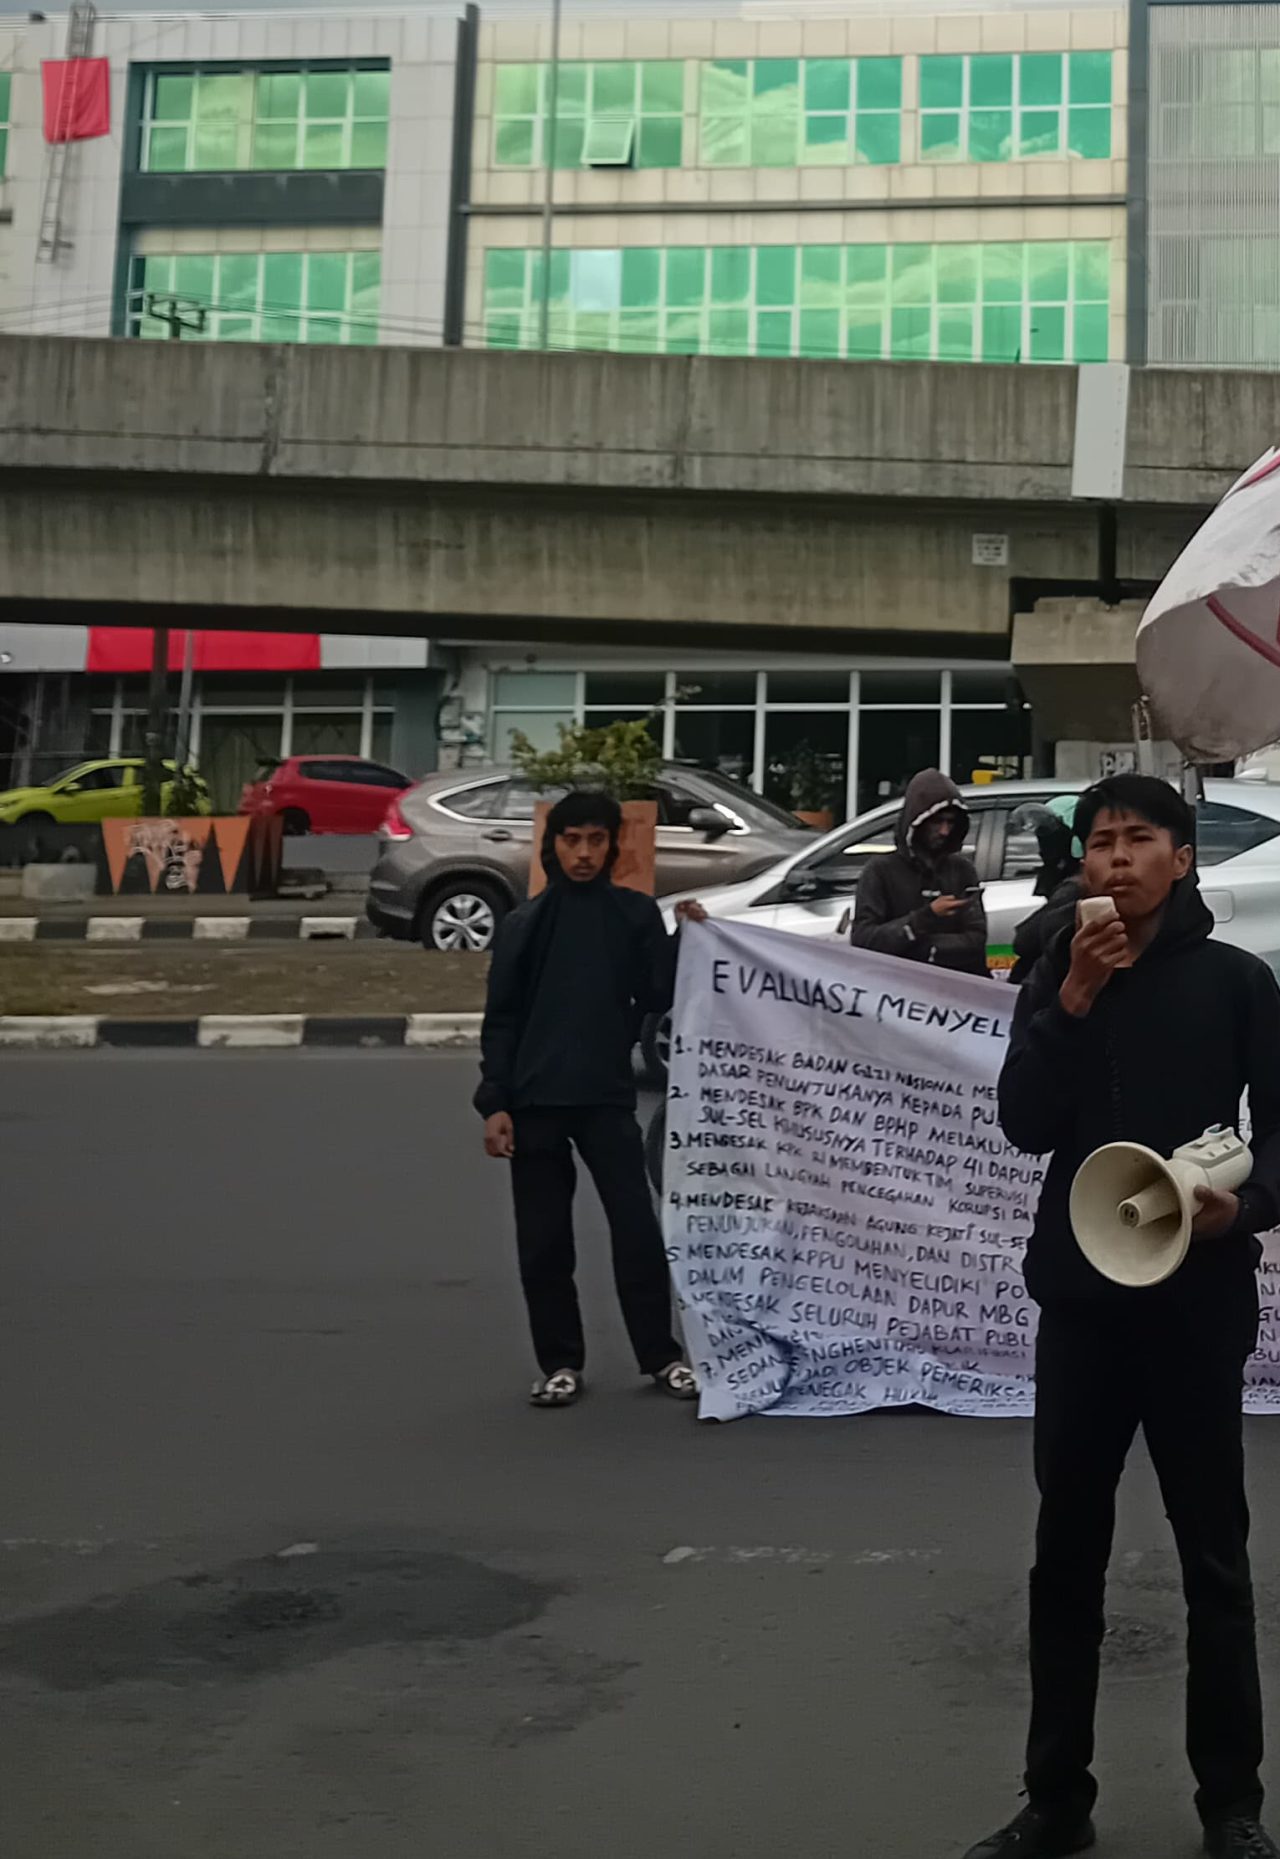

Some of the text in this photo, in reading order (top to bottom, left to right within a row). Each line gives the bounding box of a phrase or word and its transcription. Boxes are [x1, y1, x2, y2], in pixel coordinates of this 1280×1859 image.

[712, 959, 1006, 1038] EVALUASI MENYEL
[699, 1039, 787, 1066] MENDESAK
[792, 1051, 848, 1075] BADAN
[698, 1062, 750, 1079] DASAR
[901, 1093, 963, 1120] KEPADA
[700, 1086, 786, 1111] MENDESAK
[829, 1106, 866, 1126] DAN
[698, 1106, 767, 1129] SUL-SEL
[871, 1138, 958, 1174] TERHADAP
[988, 1161, 1044, 1186] DAPUR
[686, 1161, 756, 1178] SEBAGAI
[687, 1242, 787, 1263] MENDESAK
[792, 1249, 844, 1270] KPPU
[854, 1259, 980, 1296] MENYELIDIKI
[887, 1317, 976, 1341] PEJABAT
[909, 1296, 968, 1318] DAPUR
[980, 1304, 1029, 1327] MBG
